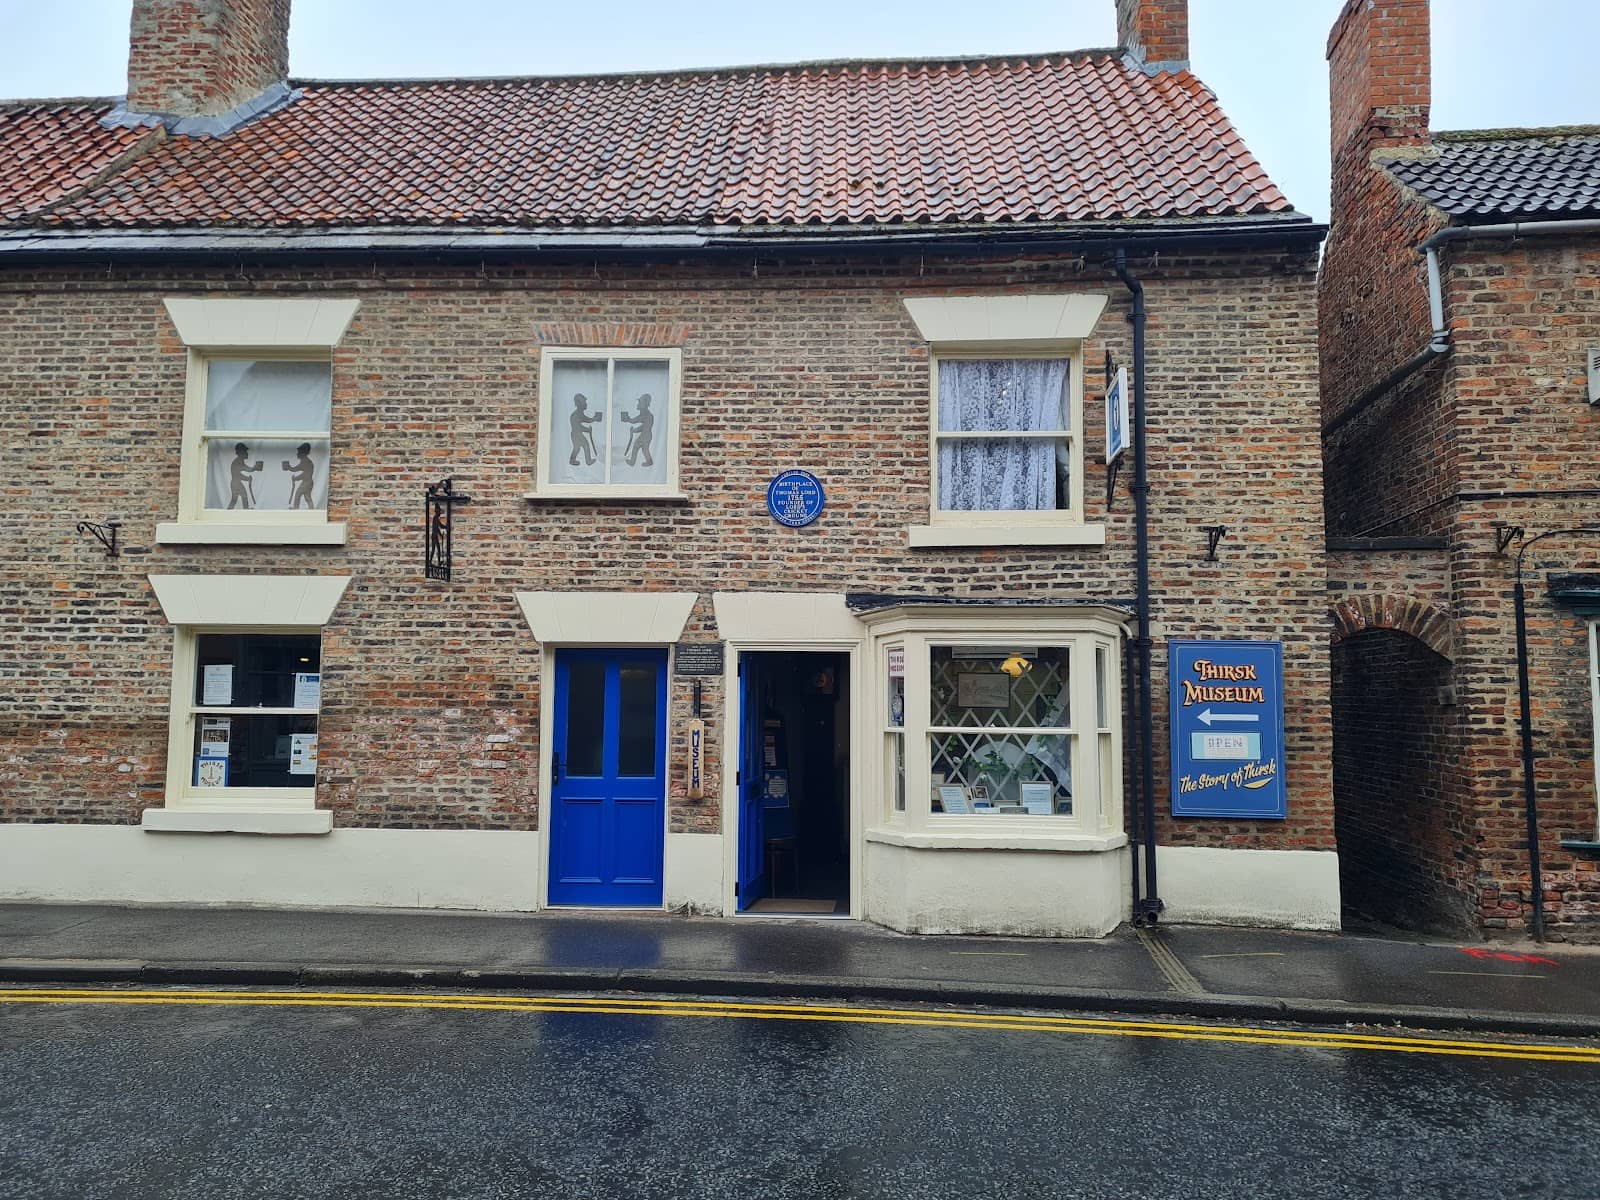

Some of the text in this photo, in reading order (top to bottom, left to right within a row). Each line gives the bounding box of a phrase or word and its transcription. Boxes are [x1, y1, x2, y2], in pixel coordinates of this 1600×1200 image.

[1193, 659, 1257, 680] THIRSK
[1182, 680, 1264, 707] MUSEUM
[1208, 737, 1243, 748] OPEN
[692, 729, 700, 788] MUSEUM
[1180, 758, 1277, 793] The Story of Thirsk
